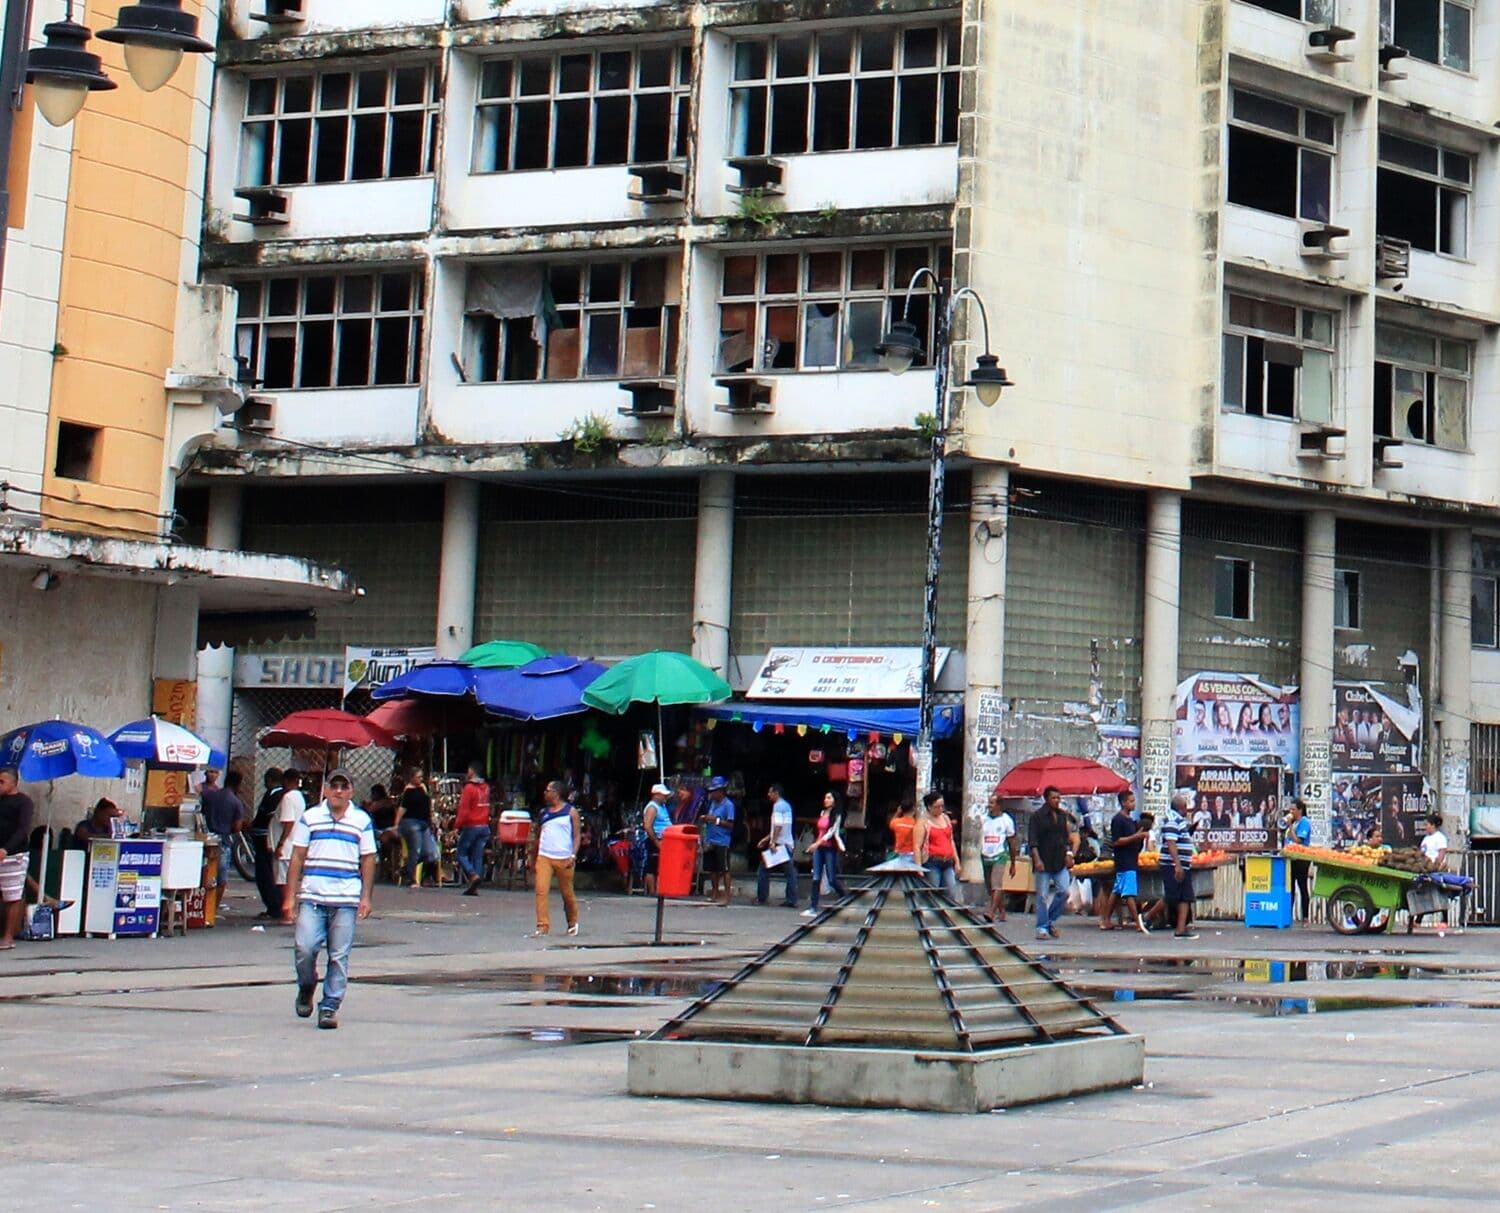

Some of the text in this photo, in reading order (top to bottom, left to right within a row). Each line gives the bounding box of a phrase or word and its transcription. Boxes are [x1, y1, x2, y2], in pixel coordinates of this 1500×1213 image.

[977, 736, 998, 756] 45
[1145, 748, 1170, 756] GALO
[1305, 752, 1329, 760] GALO
[974, 774, 1000, 783] GALO
[1233, 770, 1251, 782] DOS
[1143, 778, 1163, 793] 45
[1197, 780, 1252, 793] NAMORADOS
[1303, 783, 1322, 799] 45
[1207, 830, 1237, 843] CONDE
[1239, 830, 1269, 843] DESEJO
[1251, 875, 1269, 884] aqui
[1251, 882, 1269, 890] tem
[1260, 901, 1279, 911] TIM
